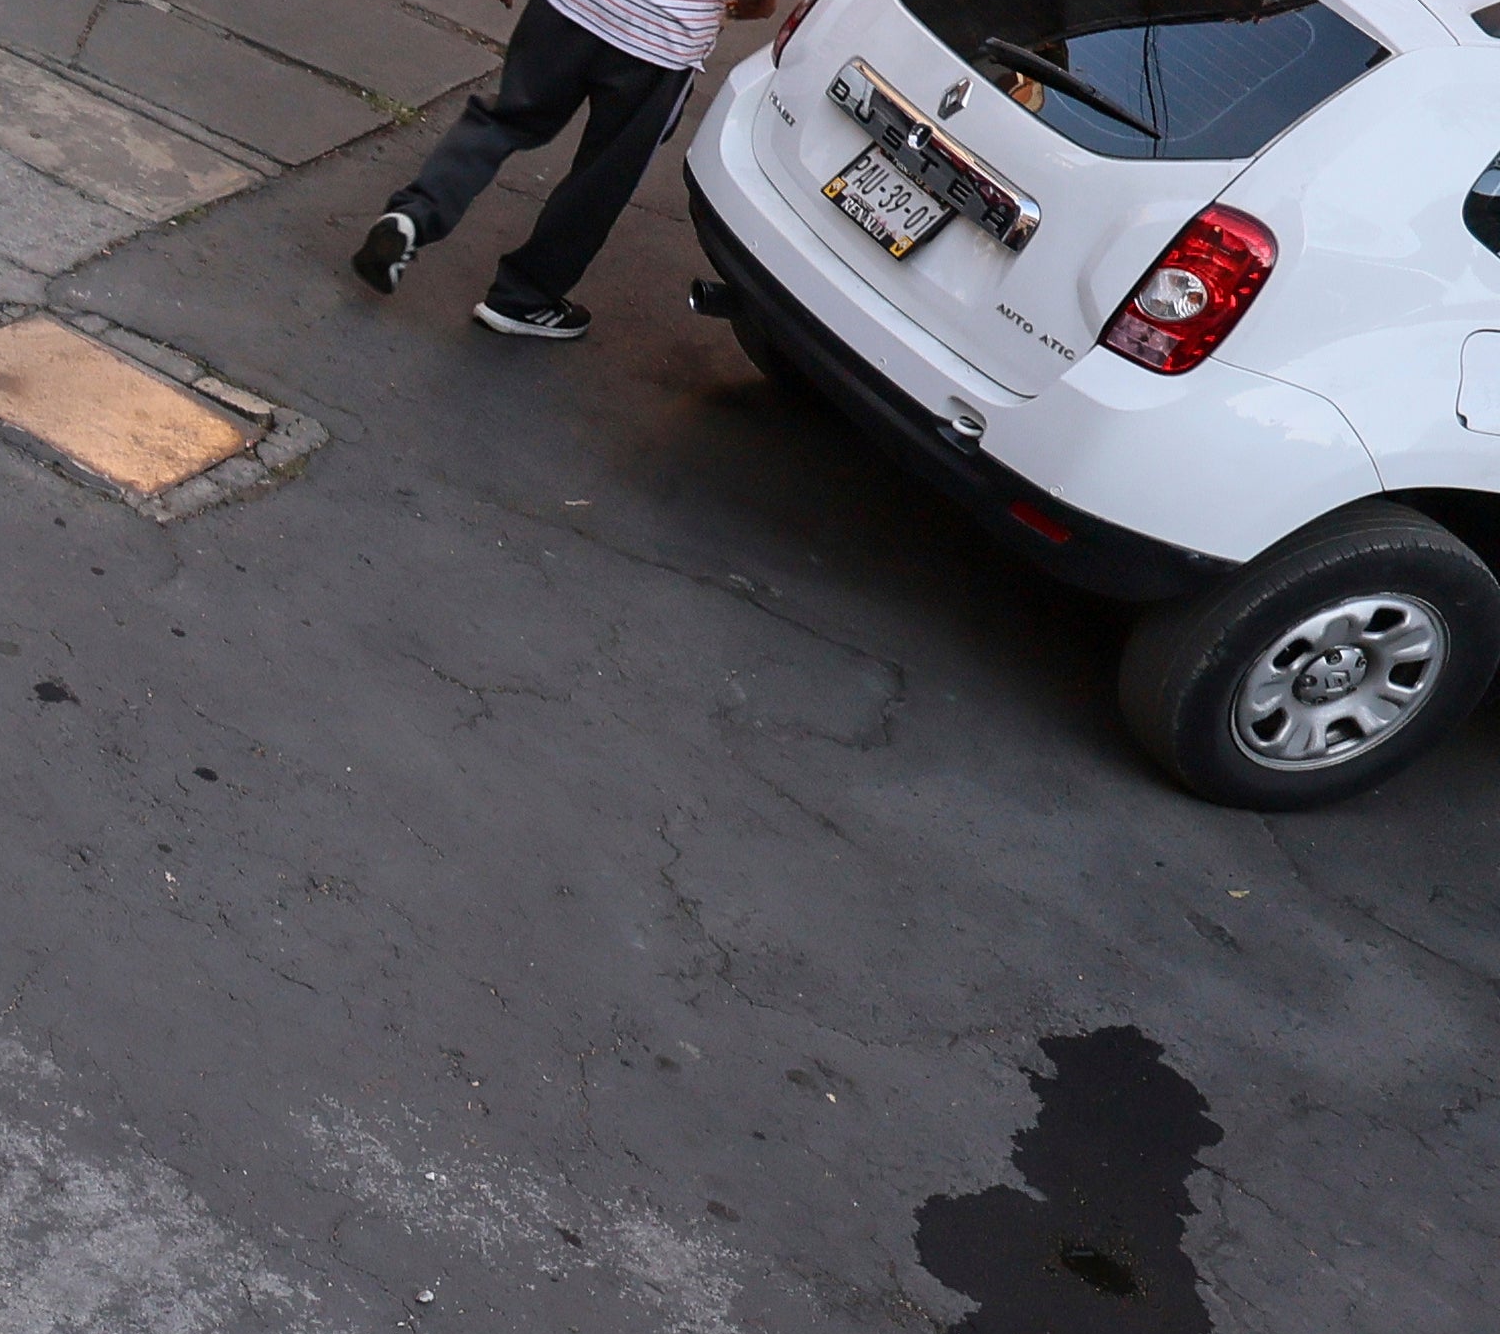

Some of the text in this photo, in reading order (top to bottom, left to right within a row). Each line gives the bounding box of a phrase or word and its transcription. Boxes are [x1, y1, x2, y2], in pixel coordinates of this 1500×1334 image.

[830, 78, 1008, 234] BUSTER
[841, 197, 891, 241] RENAULT
[850, 154, 939, 237] PAU-39-01
[996, 302, 1076, 361] AUTO ATIC
